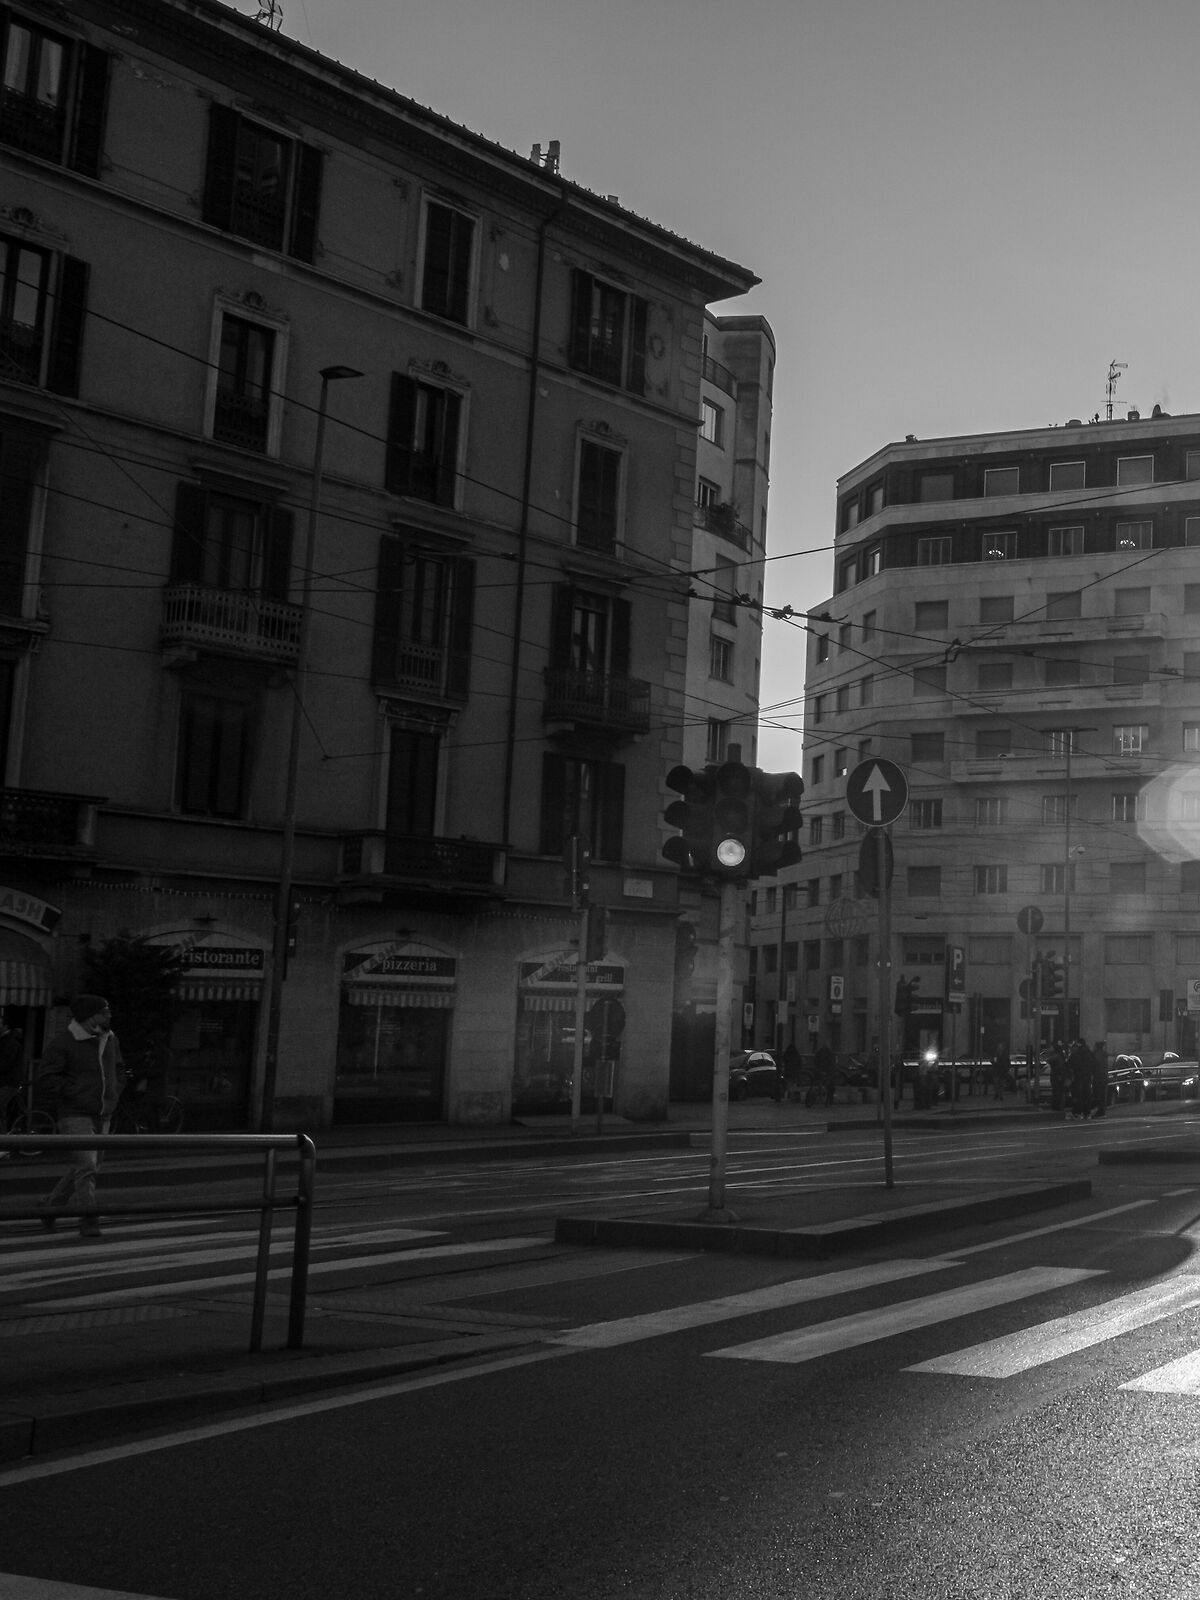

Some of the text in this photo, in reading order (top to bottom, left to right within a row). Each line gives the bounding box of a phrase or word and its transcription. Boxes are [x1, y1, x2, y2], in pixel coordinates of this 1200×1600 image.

[180, 947, 260, 965] ristorante
[953, 948, 963, 971] P
[382, 958, 438, 973] pizzeria
